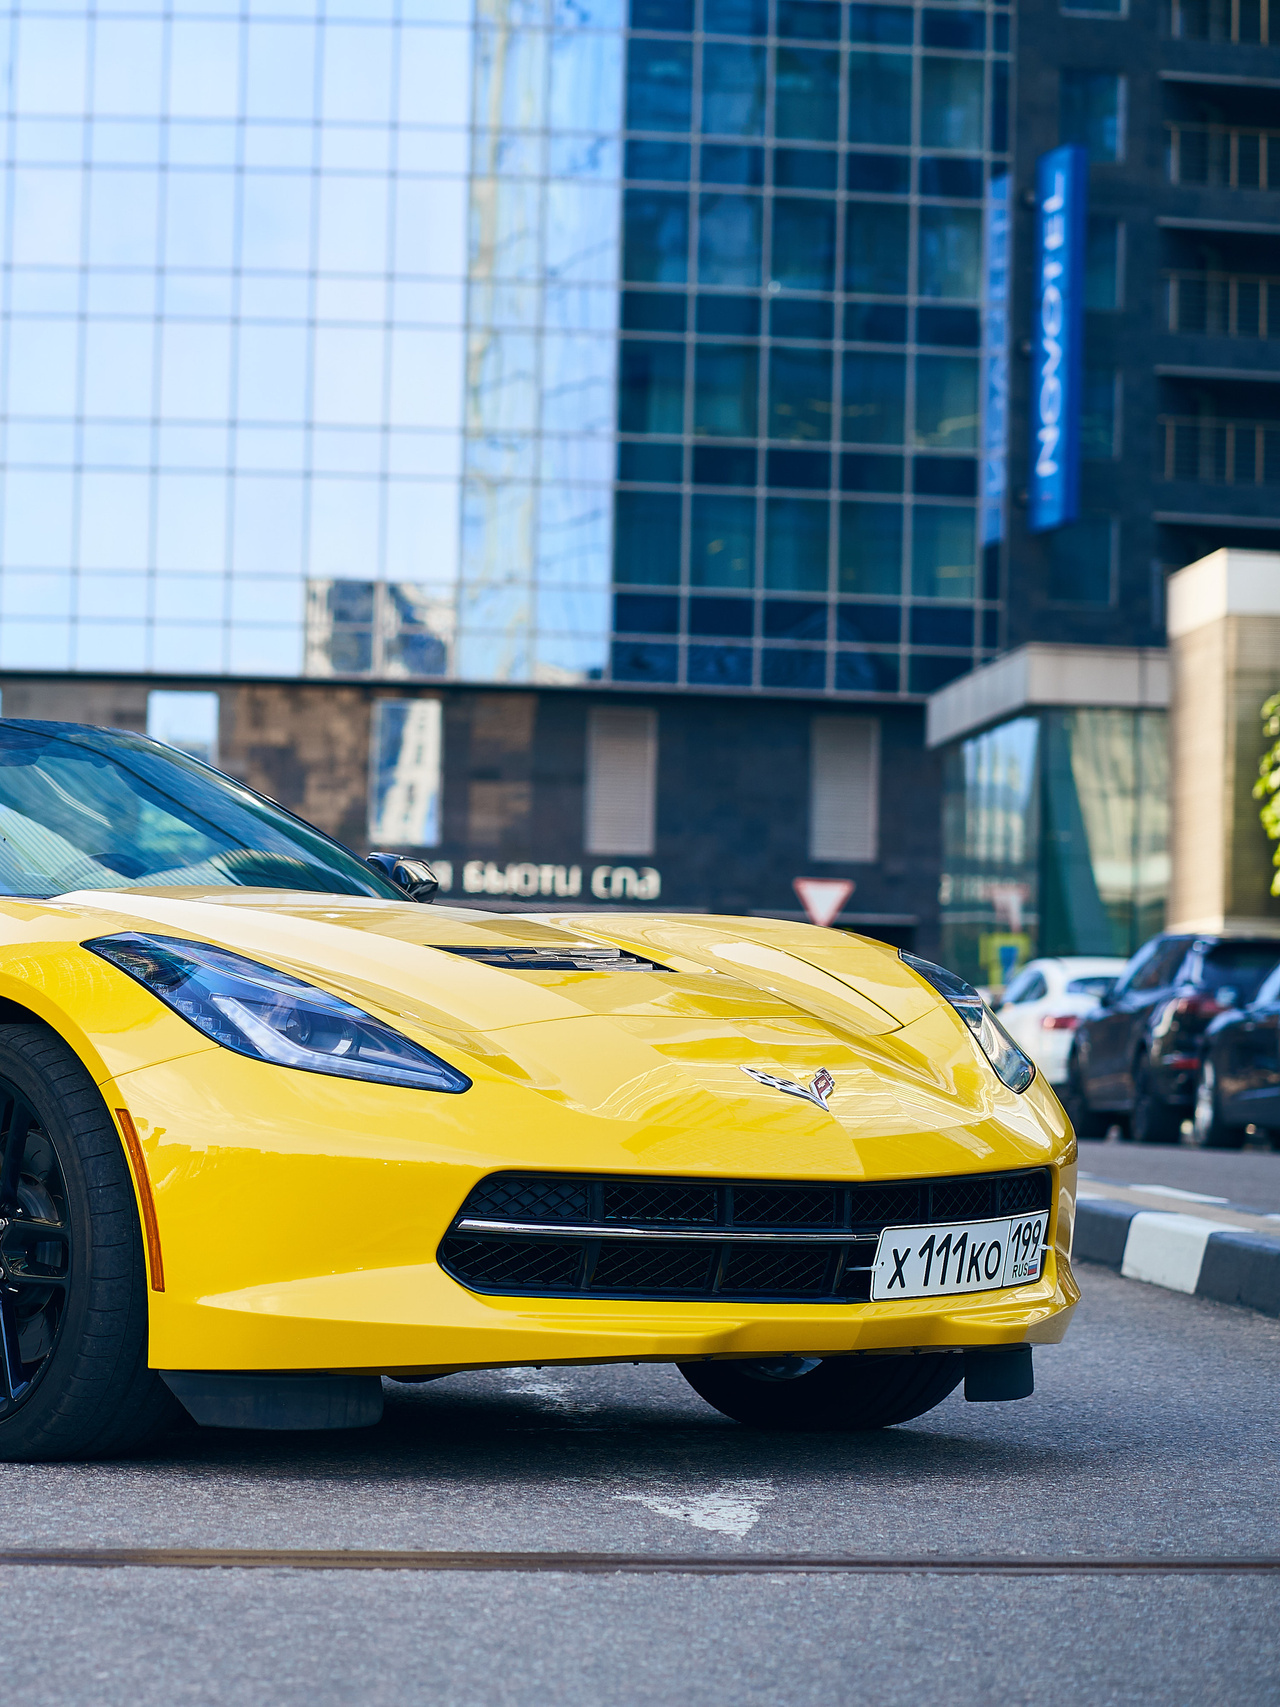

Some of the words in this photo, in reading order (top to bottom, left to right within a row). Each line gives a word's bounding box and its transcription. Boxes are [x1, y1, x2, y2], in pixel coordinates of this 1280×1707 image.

[1035, 170, 1065, 478] NOVOTEL
[1011, 1219, 1041, 1263] 199
[1012, 1262, 1028, 1278] RUS
